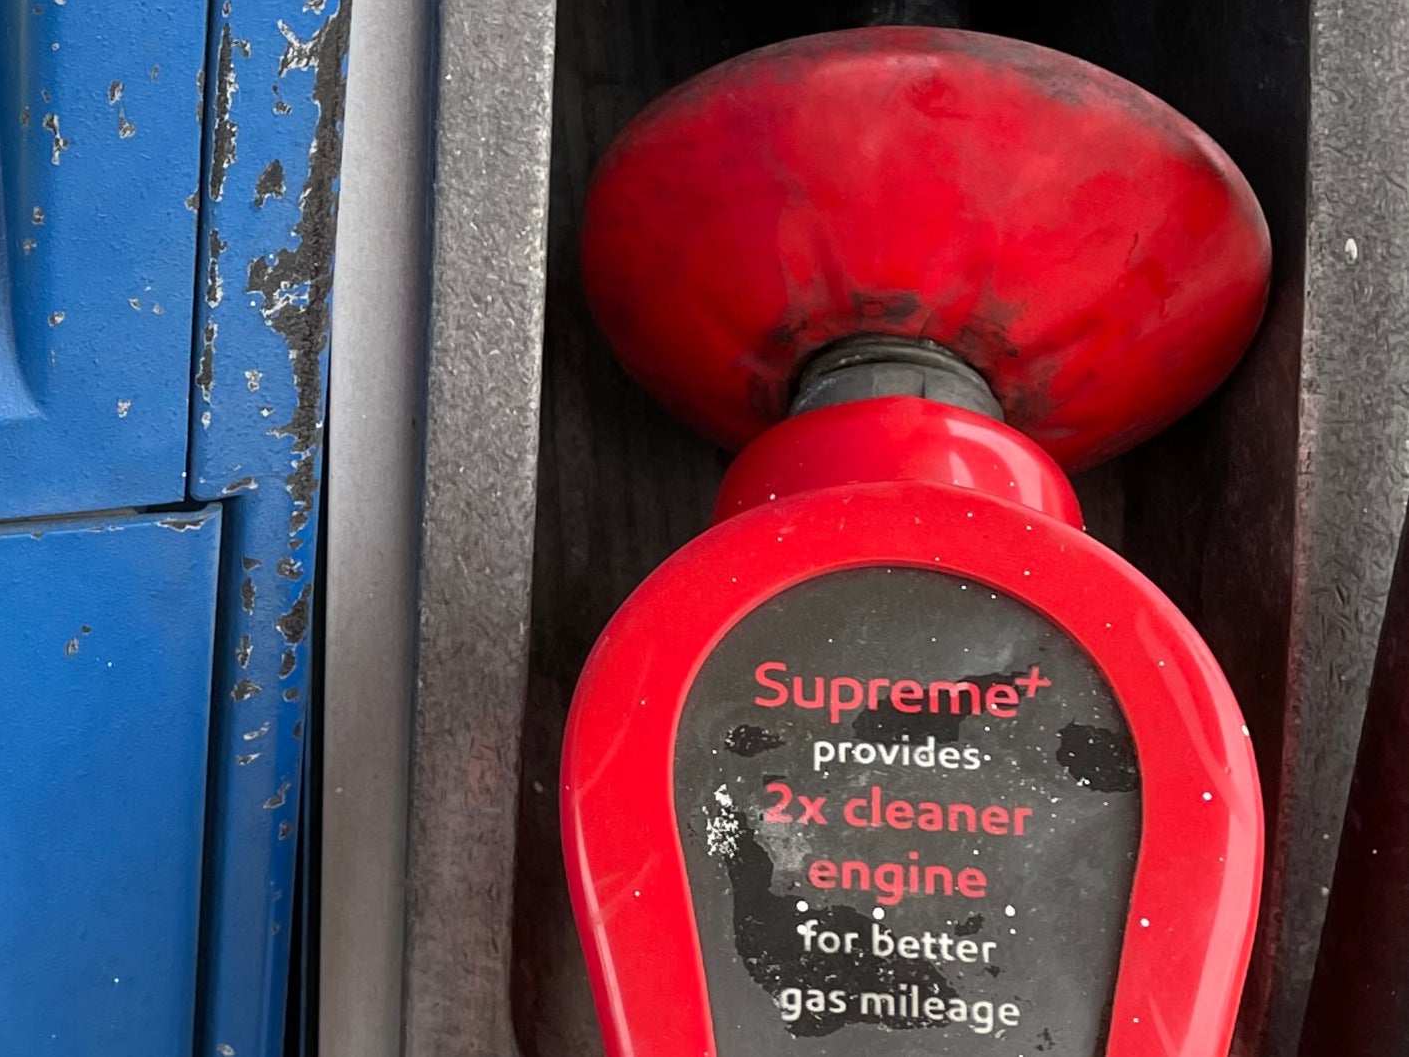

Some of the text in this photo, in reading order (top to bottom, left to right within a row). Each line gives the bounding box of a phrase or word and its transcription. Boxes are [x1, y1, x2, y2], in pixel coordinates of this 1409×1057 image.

[813, 736, 982, 771] provides
[763, 782, 1033, 836] 2x cleaner
[808, 851, 988, 906] engine
[799, 919, 997, 964] for better
[779, 984, 1021, 1035] gas mileage
